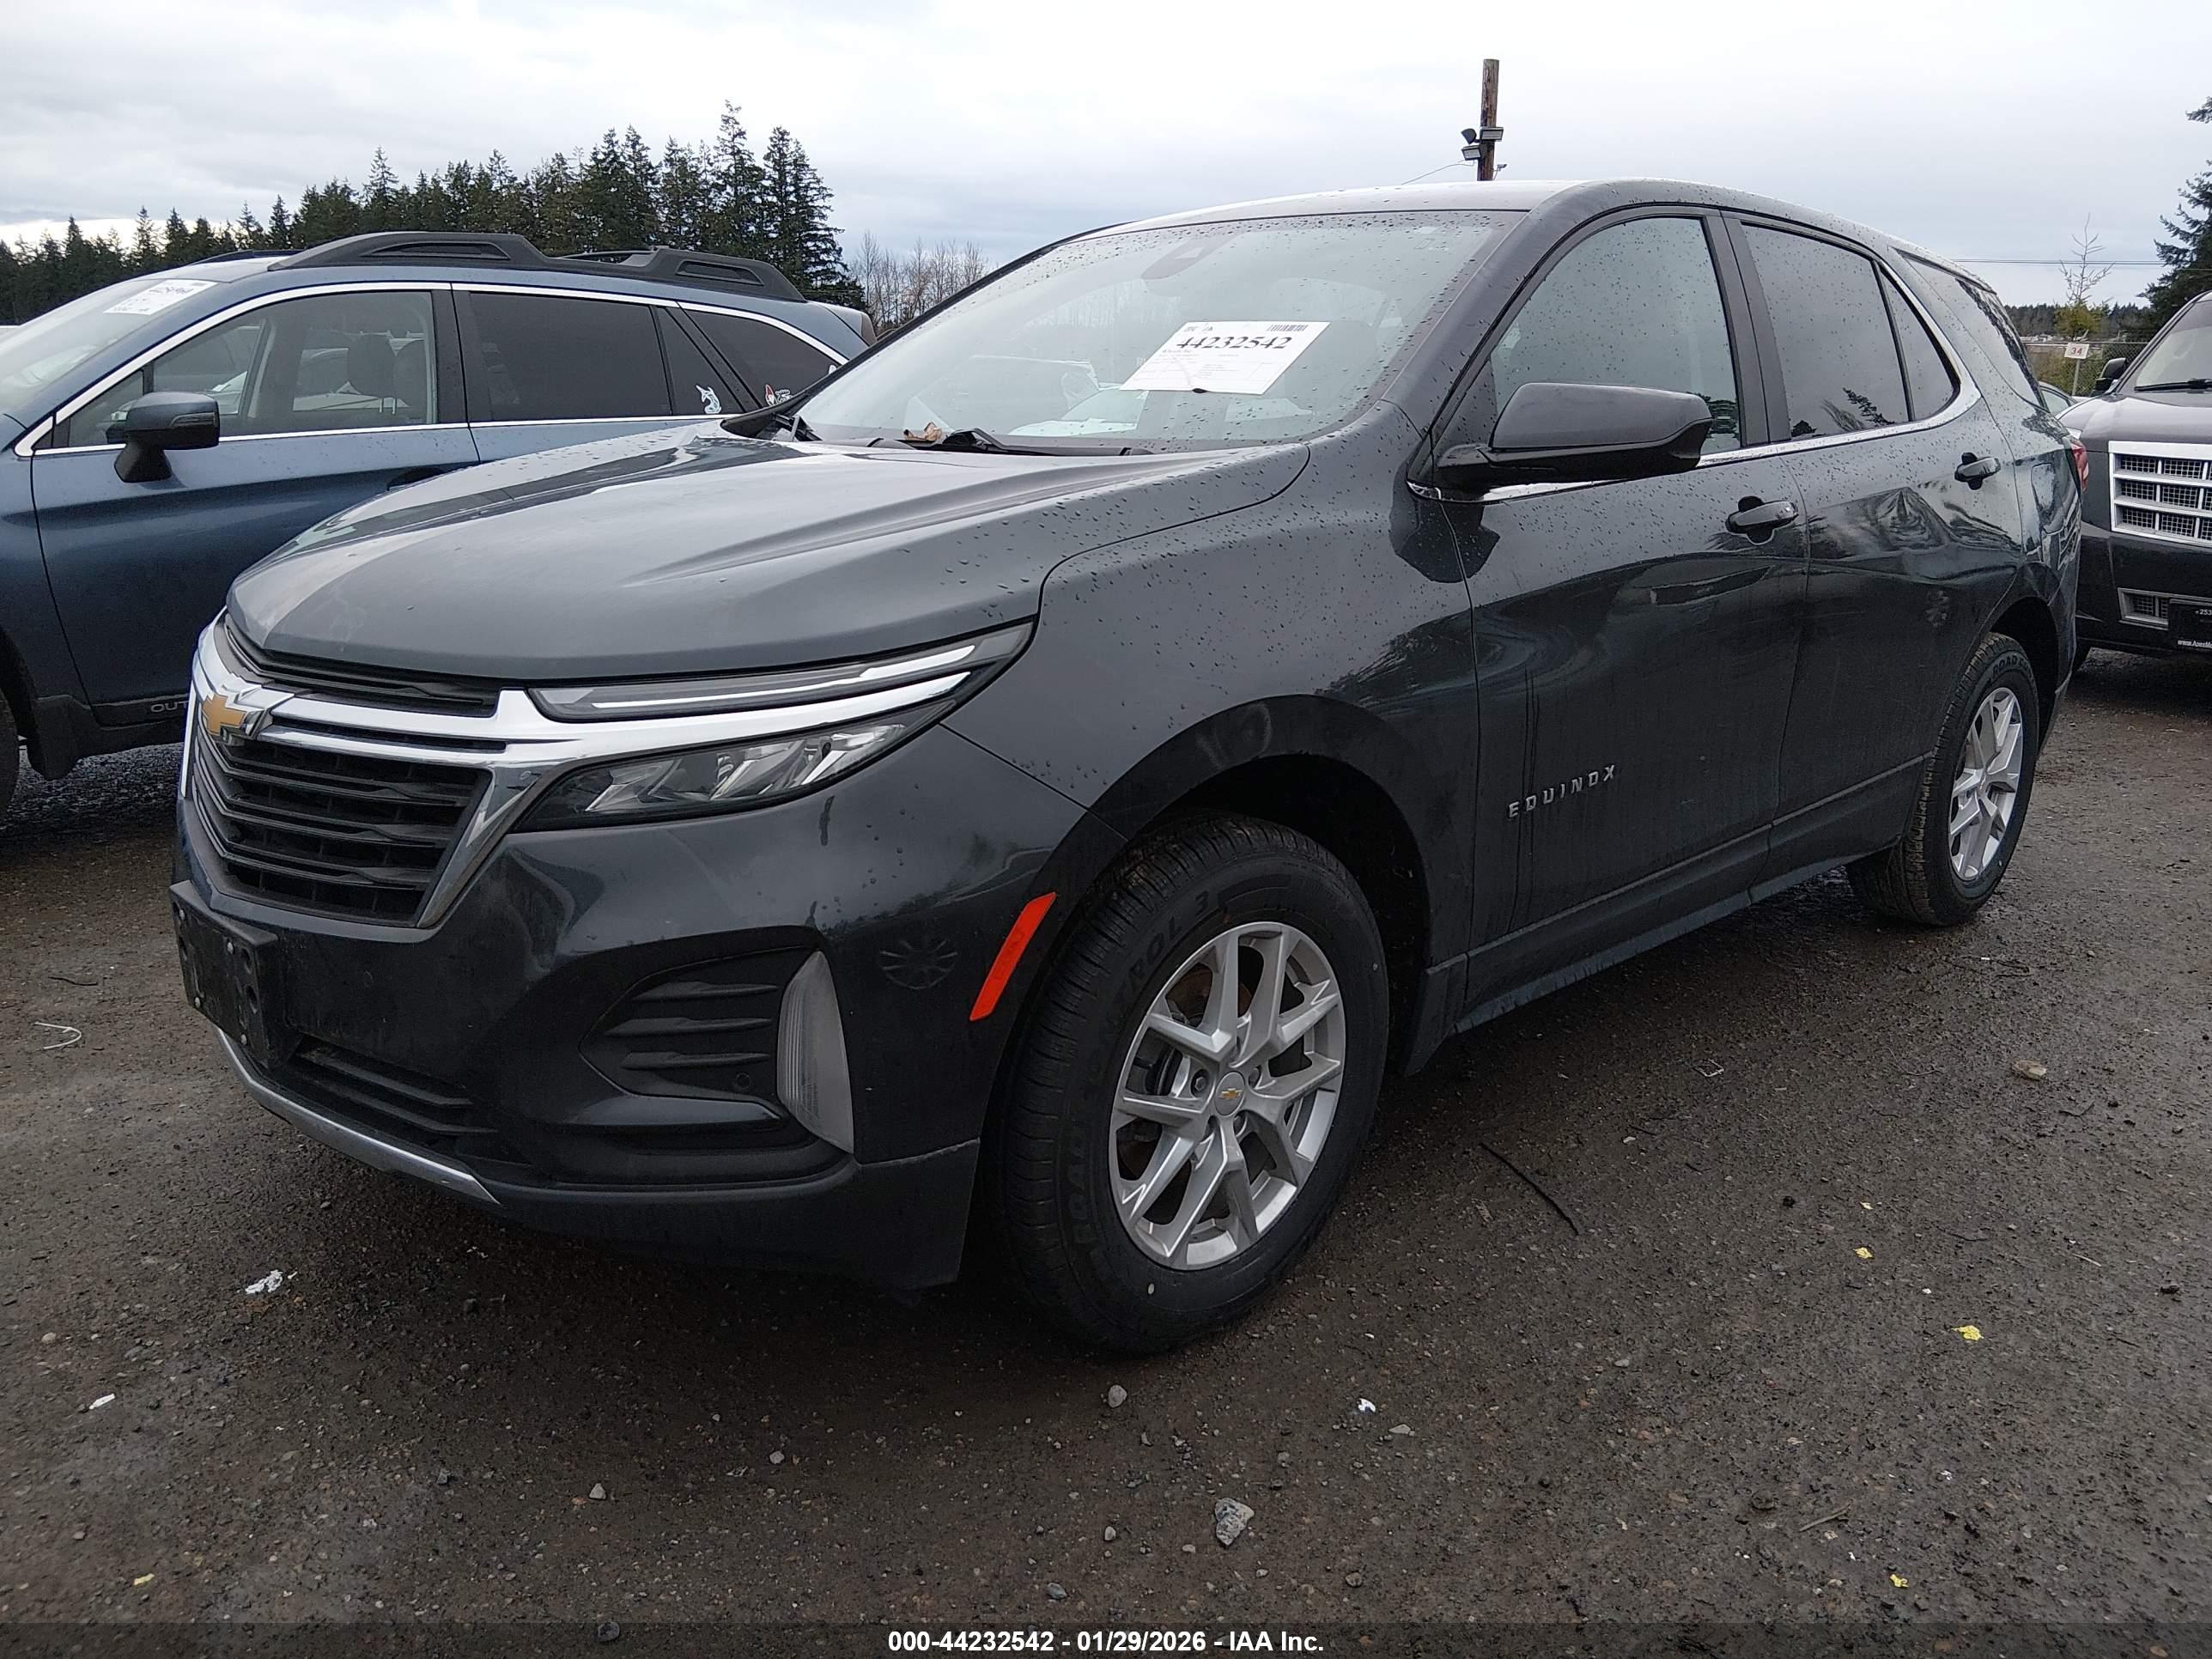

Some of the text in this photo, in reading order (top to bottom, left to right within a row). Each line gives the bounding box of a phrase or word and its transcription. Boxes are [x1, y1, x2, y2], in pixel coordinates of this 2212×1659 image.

[1176, 336, 1292, 349] 44232542
[2071, 347, 2082, 356] 34
[1508, 764, 1615, 818] EQUINOX
